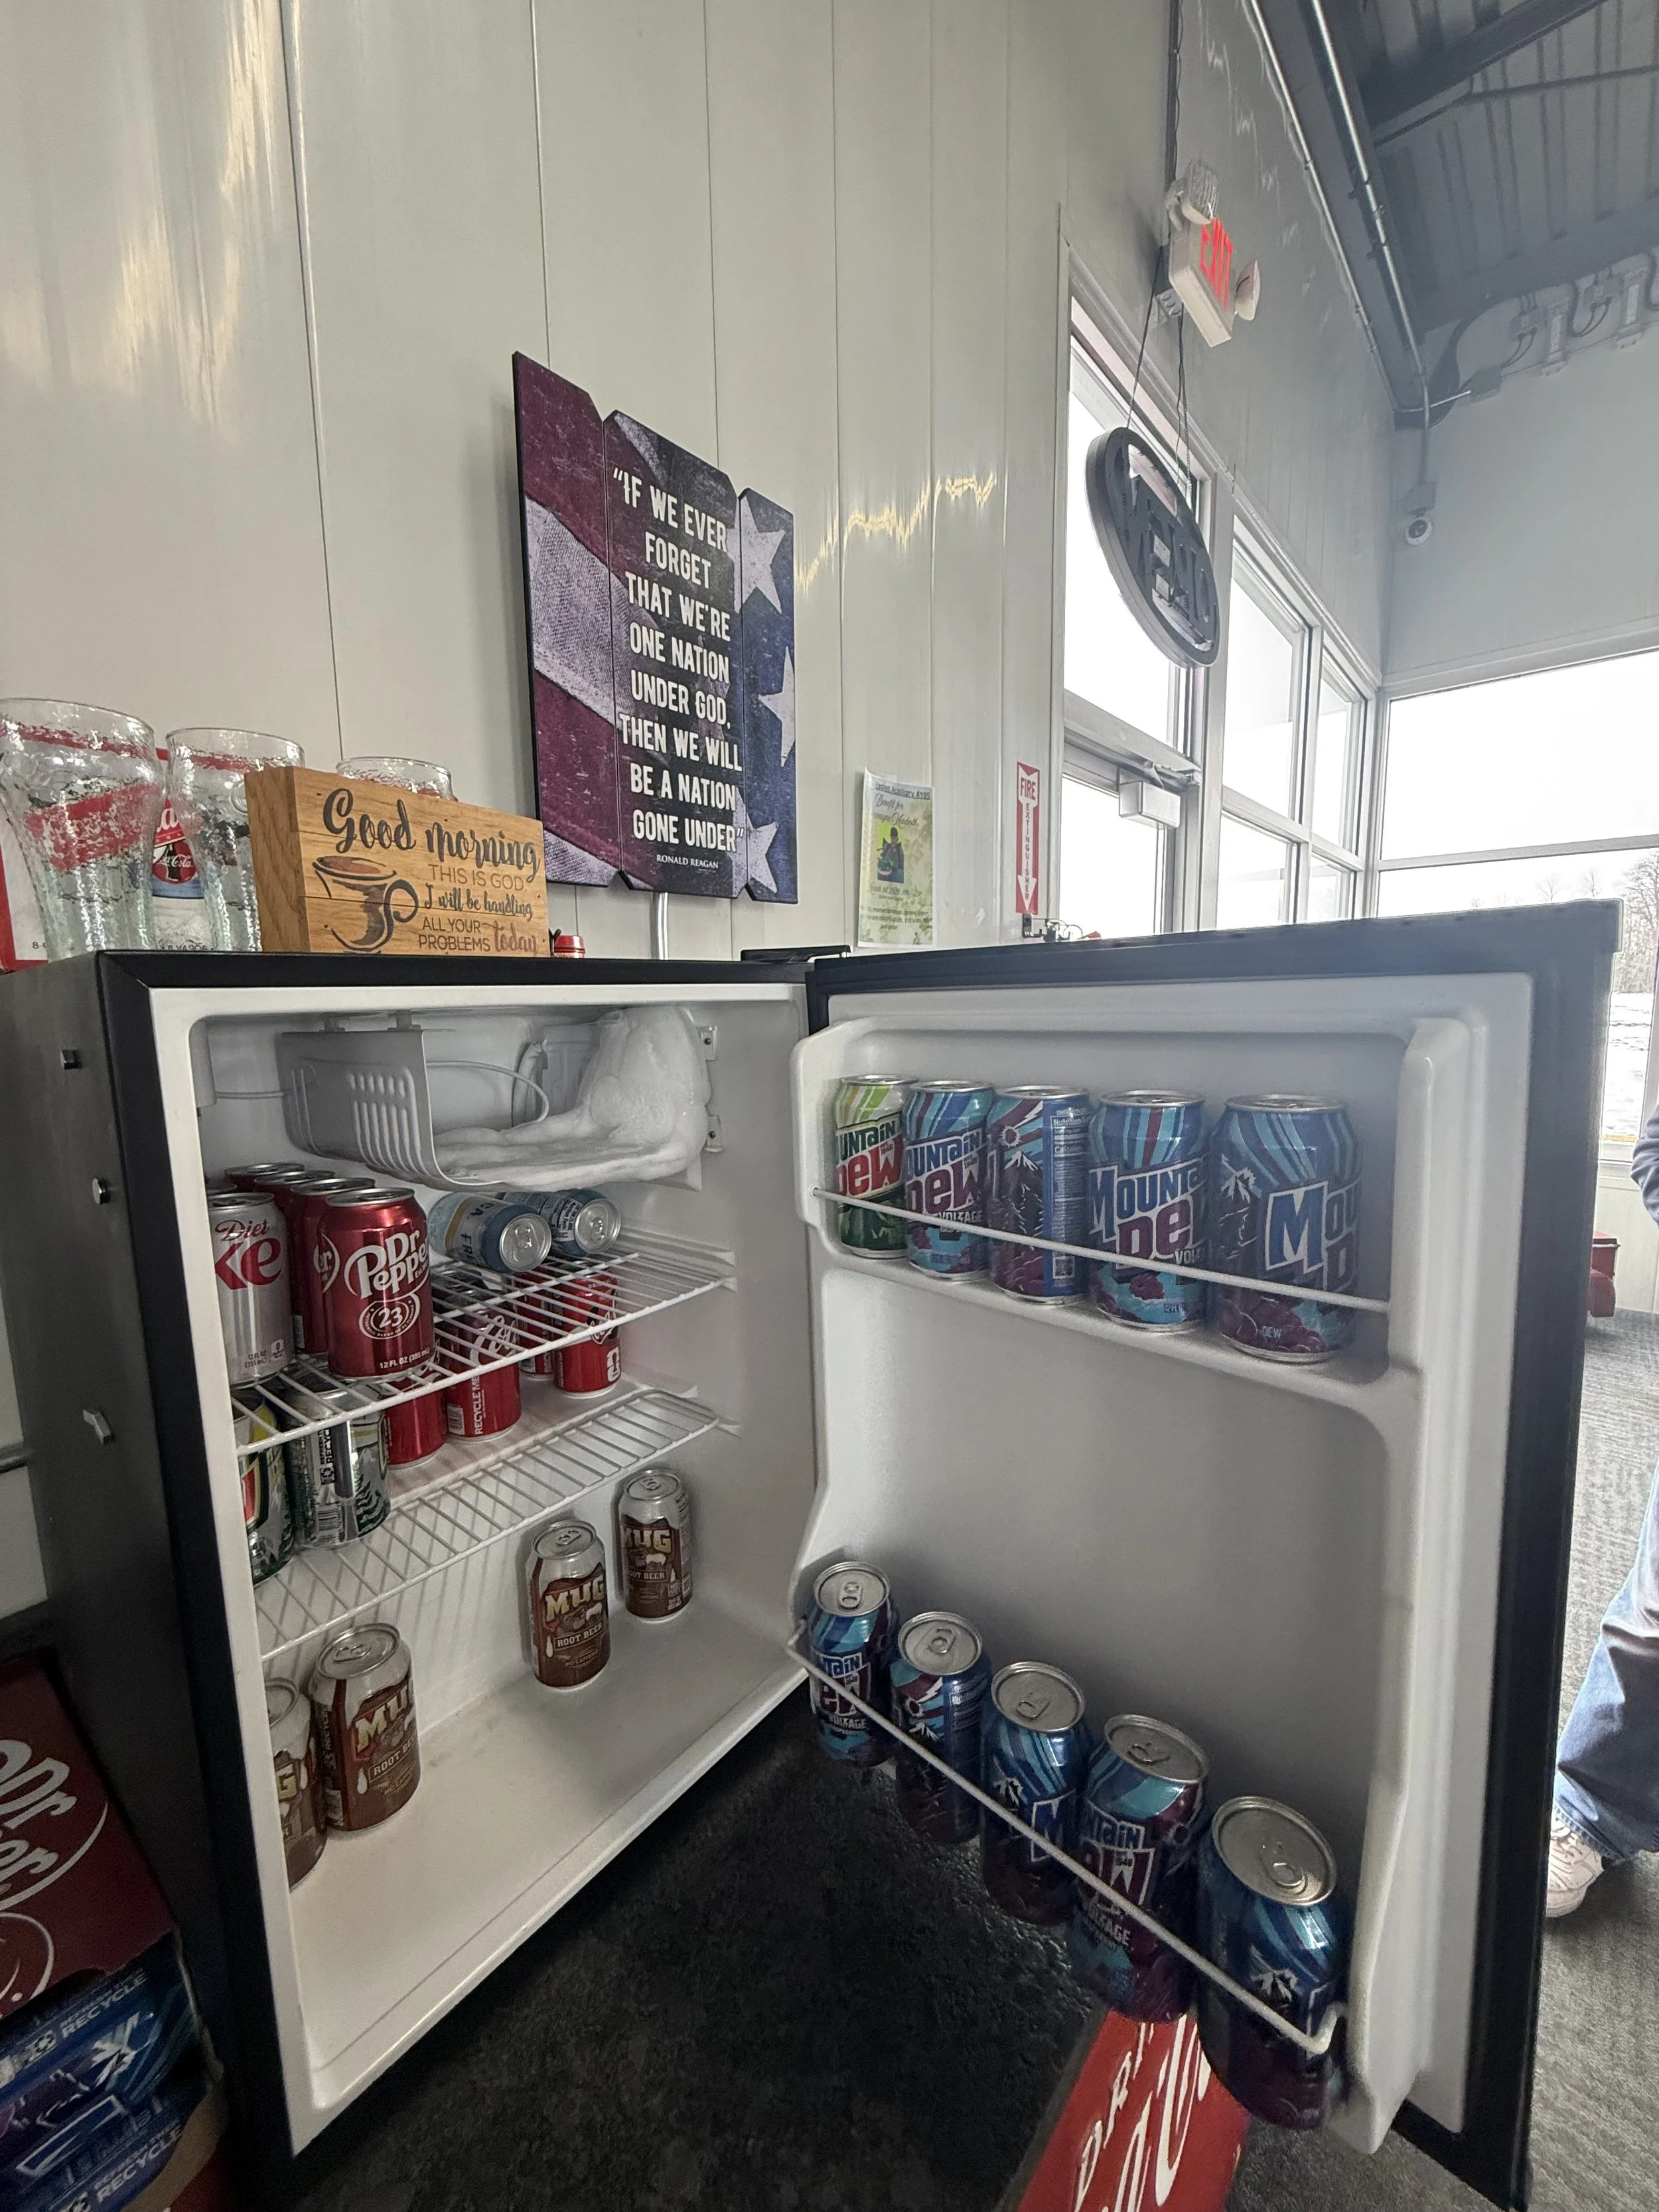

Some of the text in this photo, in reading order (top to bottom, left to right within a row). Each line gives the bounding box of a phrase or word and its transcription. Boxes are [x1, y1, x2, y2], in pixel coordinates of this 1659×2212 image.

[650, 484, 678, 528] WE
[684, 502, 727, 552] EVER
[645, 531, 711, 589] FORGET
[625, 571, 731, 642] THAT WE'RE
[630, 622, 729, 684] ONE NATION
[630, 669, 690, 715] UNDER
[618, 713, 743, 772] THEN WE WILL
[630, 763, 737, 812] BE A NATION
[1020, 776, 1036, 800] FIRE
[323, 788, 541, 883] Good morning
[632, 809, 680, 844] GONE
[427, 863, 467, 885] THIS
[472, 871, 486, 887] IS
[656, 853, 719, 869] RONALD REAGAN
[424, 883, 534, 922] I will be handling
[418, 920, 539, 956] PROBLEMS today
[422, 916, 482, 933] ALL YOUR
[938, 1210, 983, 1224] VOLTAGE
[1089, 1165, 1198, 1241] MOUNT
[215, 1219, 270, 1241] Diet
[385, 1230, 421, 1266] Dr
[346, 1237, 429, 1299] Peppe
[378, 1305, 404, 1329] 23
[379, 1361, 388, 1369] 12
[389, 1359, 398, 1368] FL
[399, 1357, 408, 1365] OZ
[472, 1390, 484, 1435] RECYCLE
[323, 1428, 334, 1465] RECYC
[545, 1574, 605, 1623] MUG
[557, 1621, 603, 1648] ROOT BEER
[355, 1684, 413, 1753] MU
[373, 1750, 401, 1777] ROOT
[62, 1972, 149, 2038] RECYCLE
[96, 2124, 182, 2203] RECYCLE
